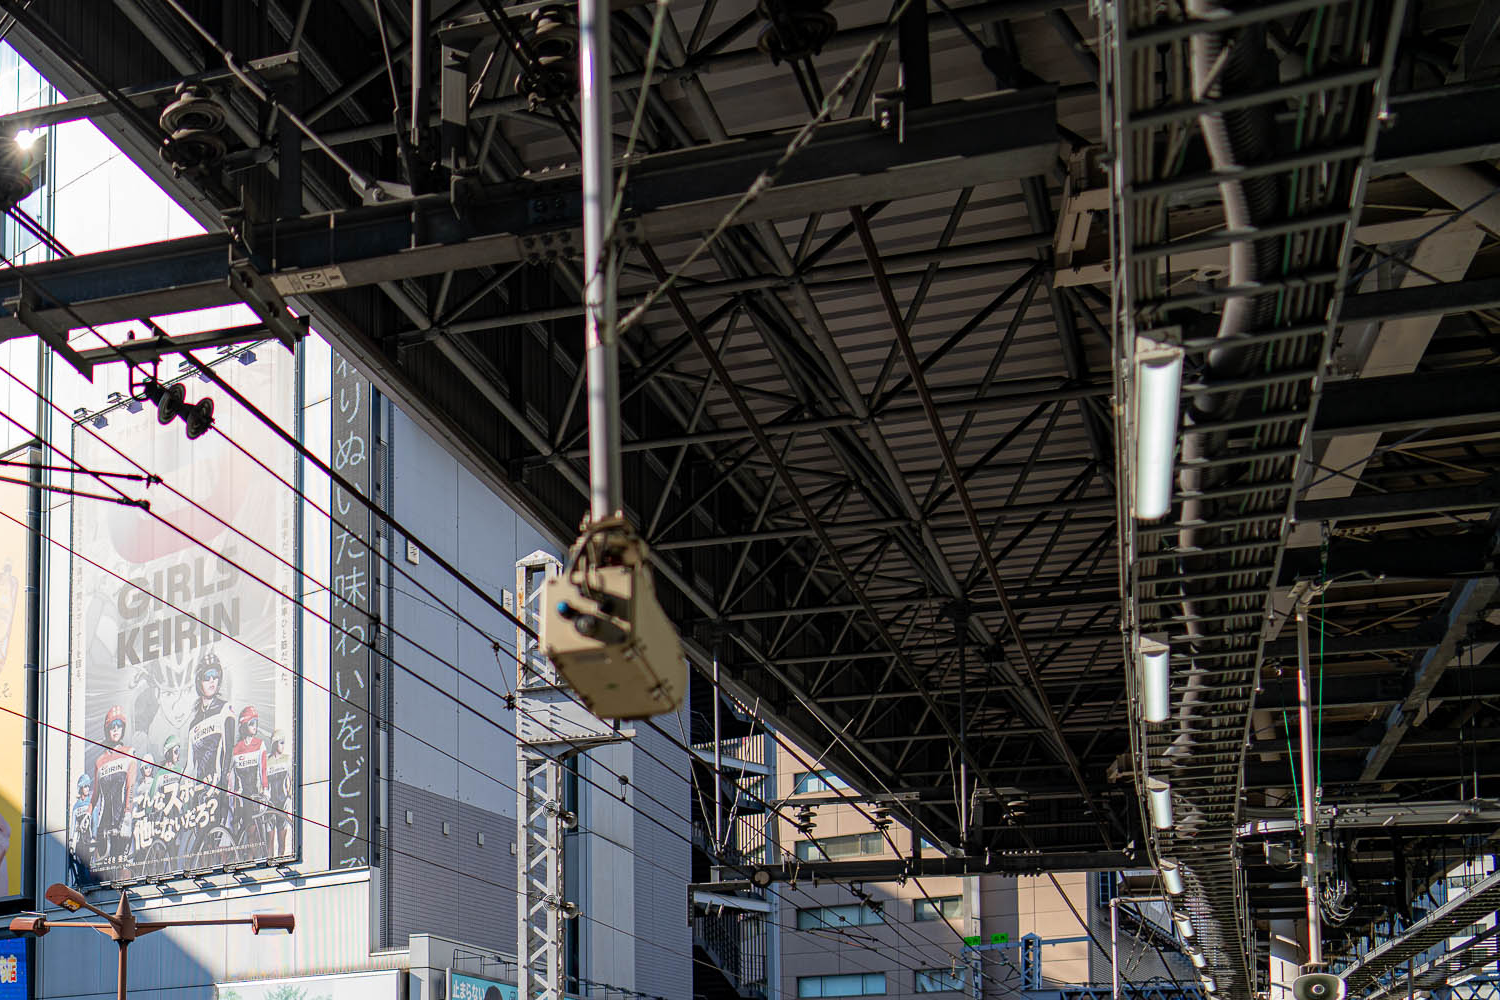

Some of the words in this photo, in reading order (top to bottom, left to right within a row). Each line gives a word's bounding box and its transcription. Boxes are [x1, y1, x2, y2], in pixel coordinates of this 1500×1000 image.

[116, 546, 241, 620] GIRLS
[116, 598, 241, 670] KEIRIN
[132, 772, 220, 818] こんなスポーツ
